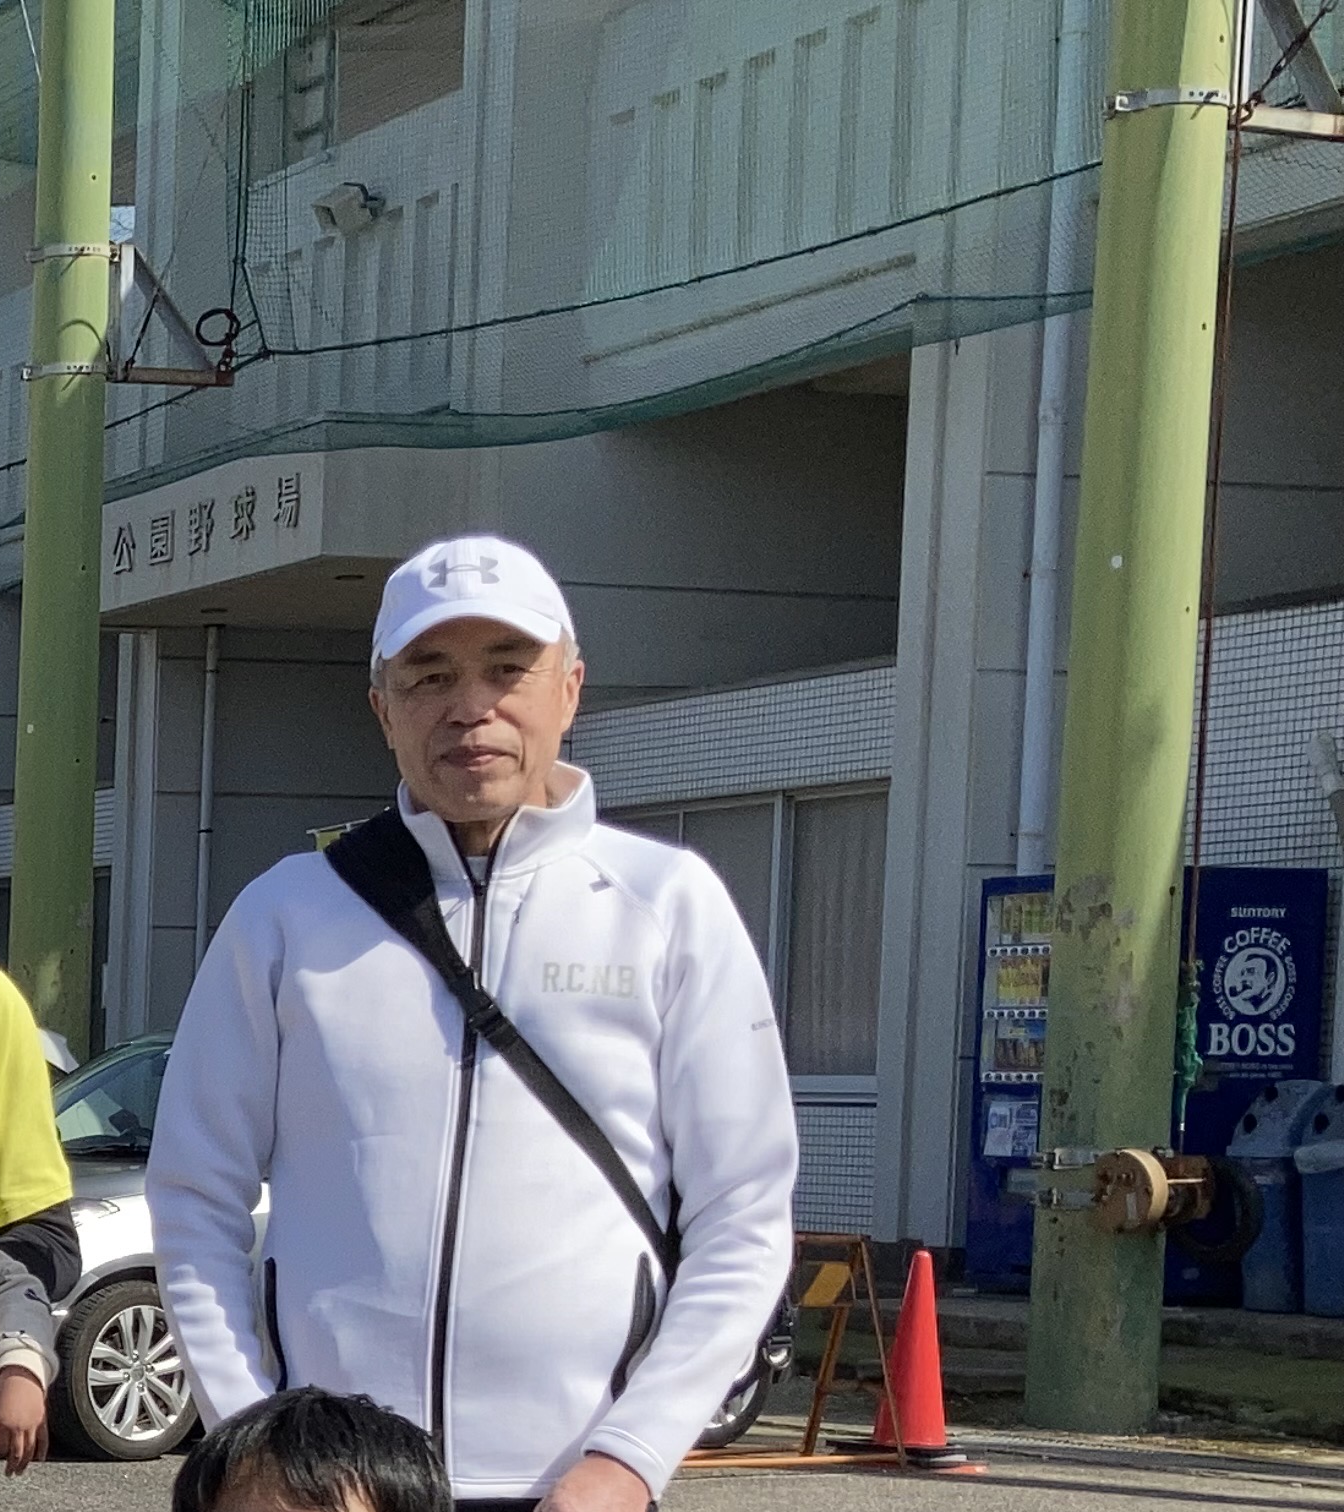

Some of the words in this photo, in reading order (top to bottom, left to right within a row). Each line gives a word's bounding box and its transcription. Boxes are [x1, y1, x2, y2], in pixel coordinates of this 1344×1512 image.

[113, 472, 301, 575] 公園野球場
[1230, 906, 1287, 918] SUNTORY
[1224, 926, 1291, 955] COFFEE
[1206, 1022, 1296, 1056] BOSS
